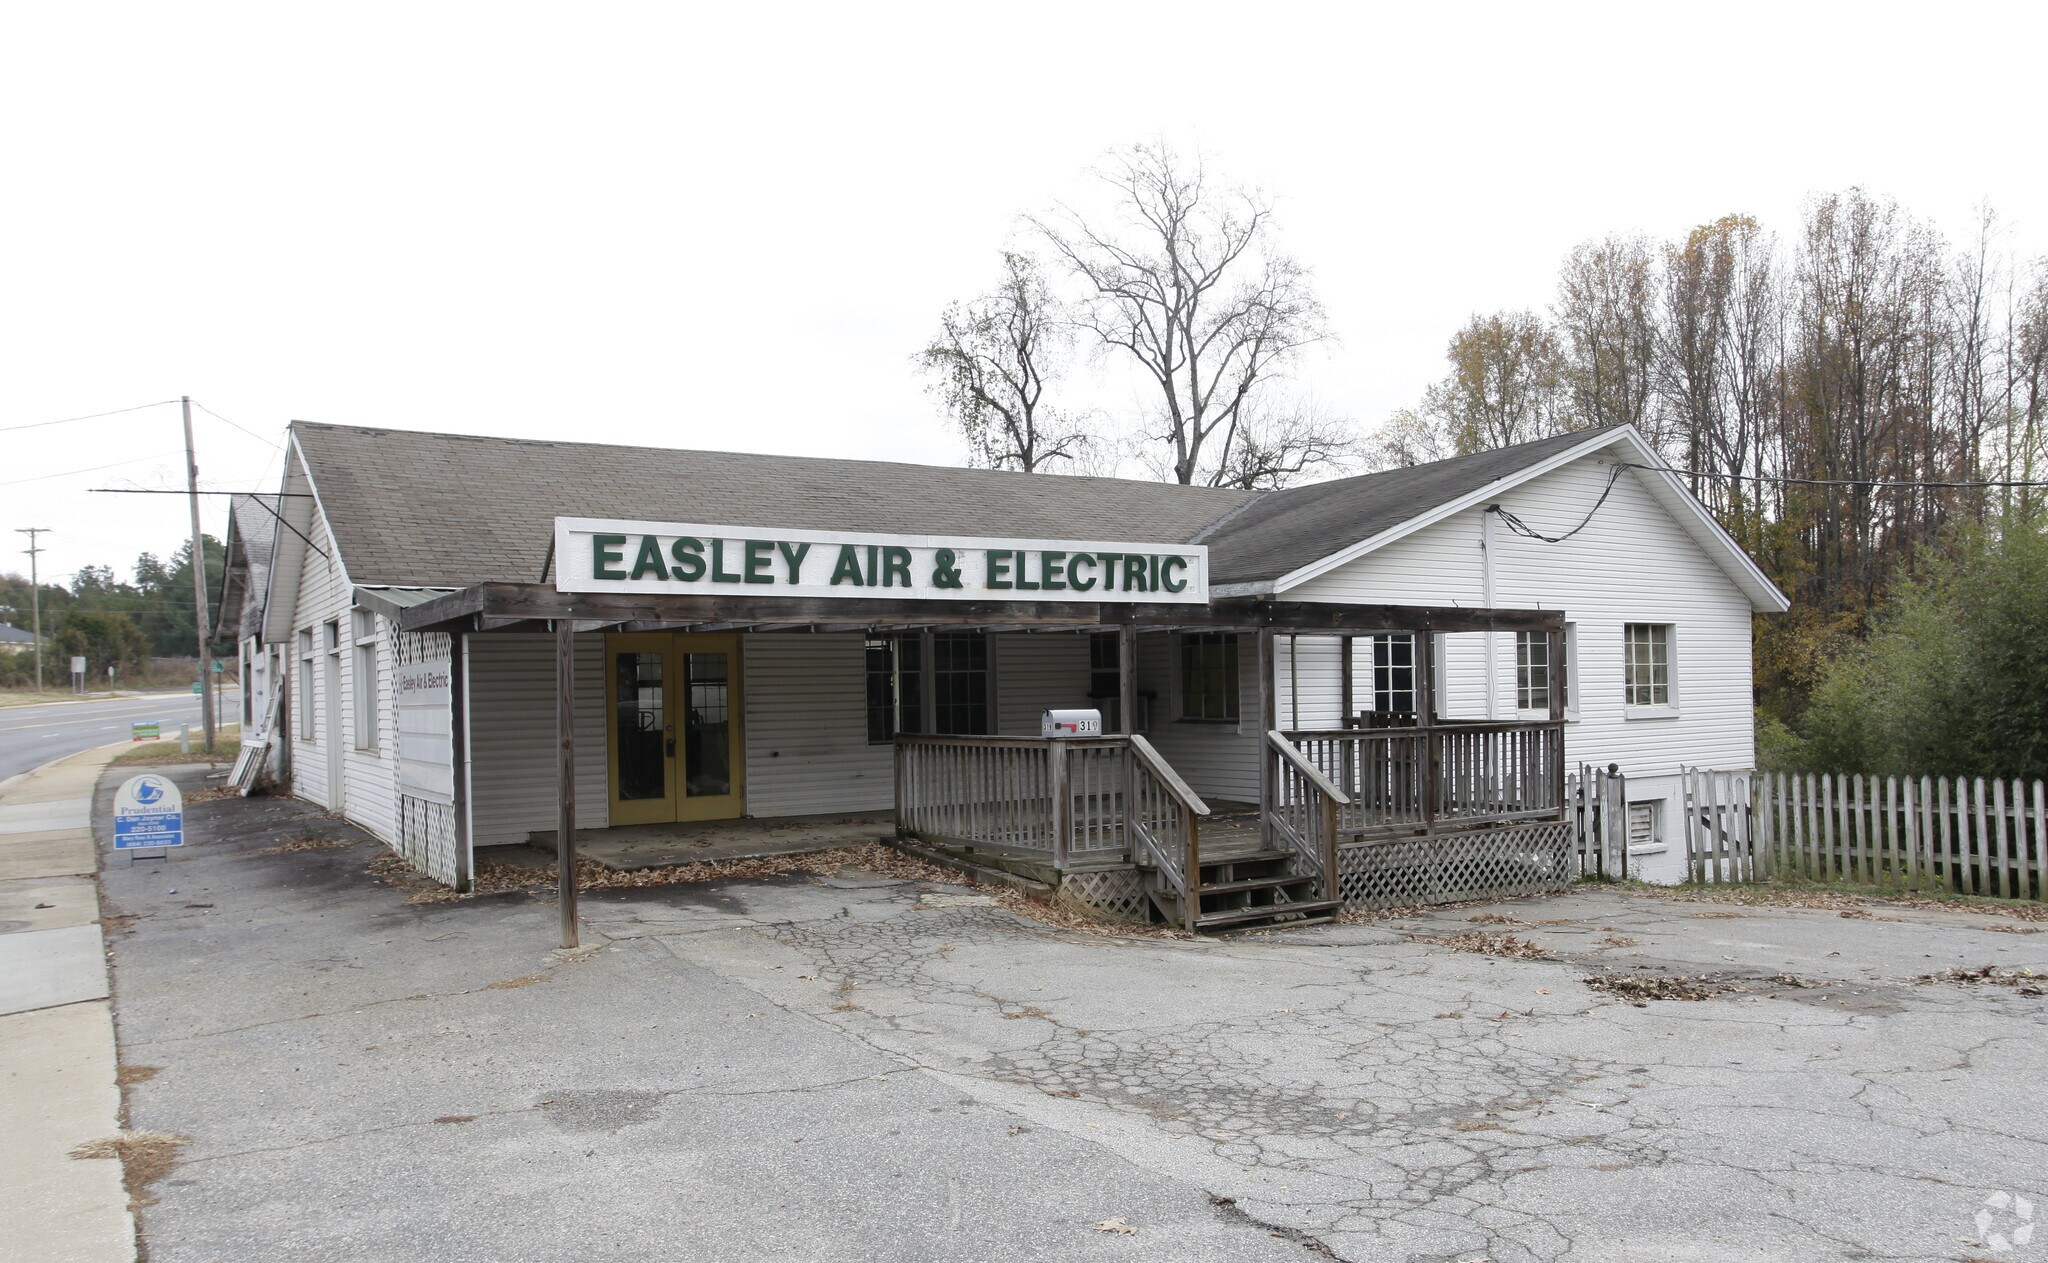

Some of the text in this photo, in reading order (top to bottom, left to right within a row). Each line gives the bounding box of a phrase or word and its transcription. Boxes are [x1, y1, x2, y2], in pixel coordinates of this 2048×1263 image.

[592, 534, 1188, 592] EASLEY AIR & ELECTRIC
[403, 675, 416, 693] Easley
[428, 671, 448, 688] Electric
[1080, 721, 1098, 731] 319
[121, 805, 175, 815] Prudential
